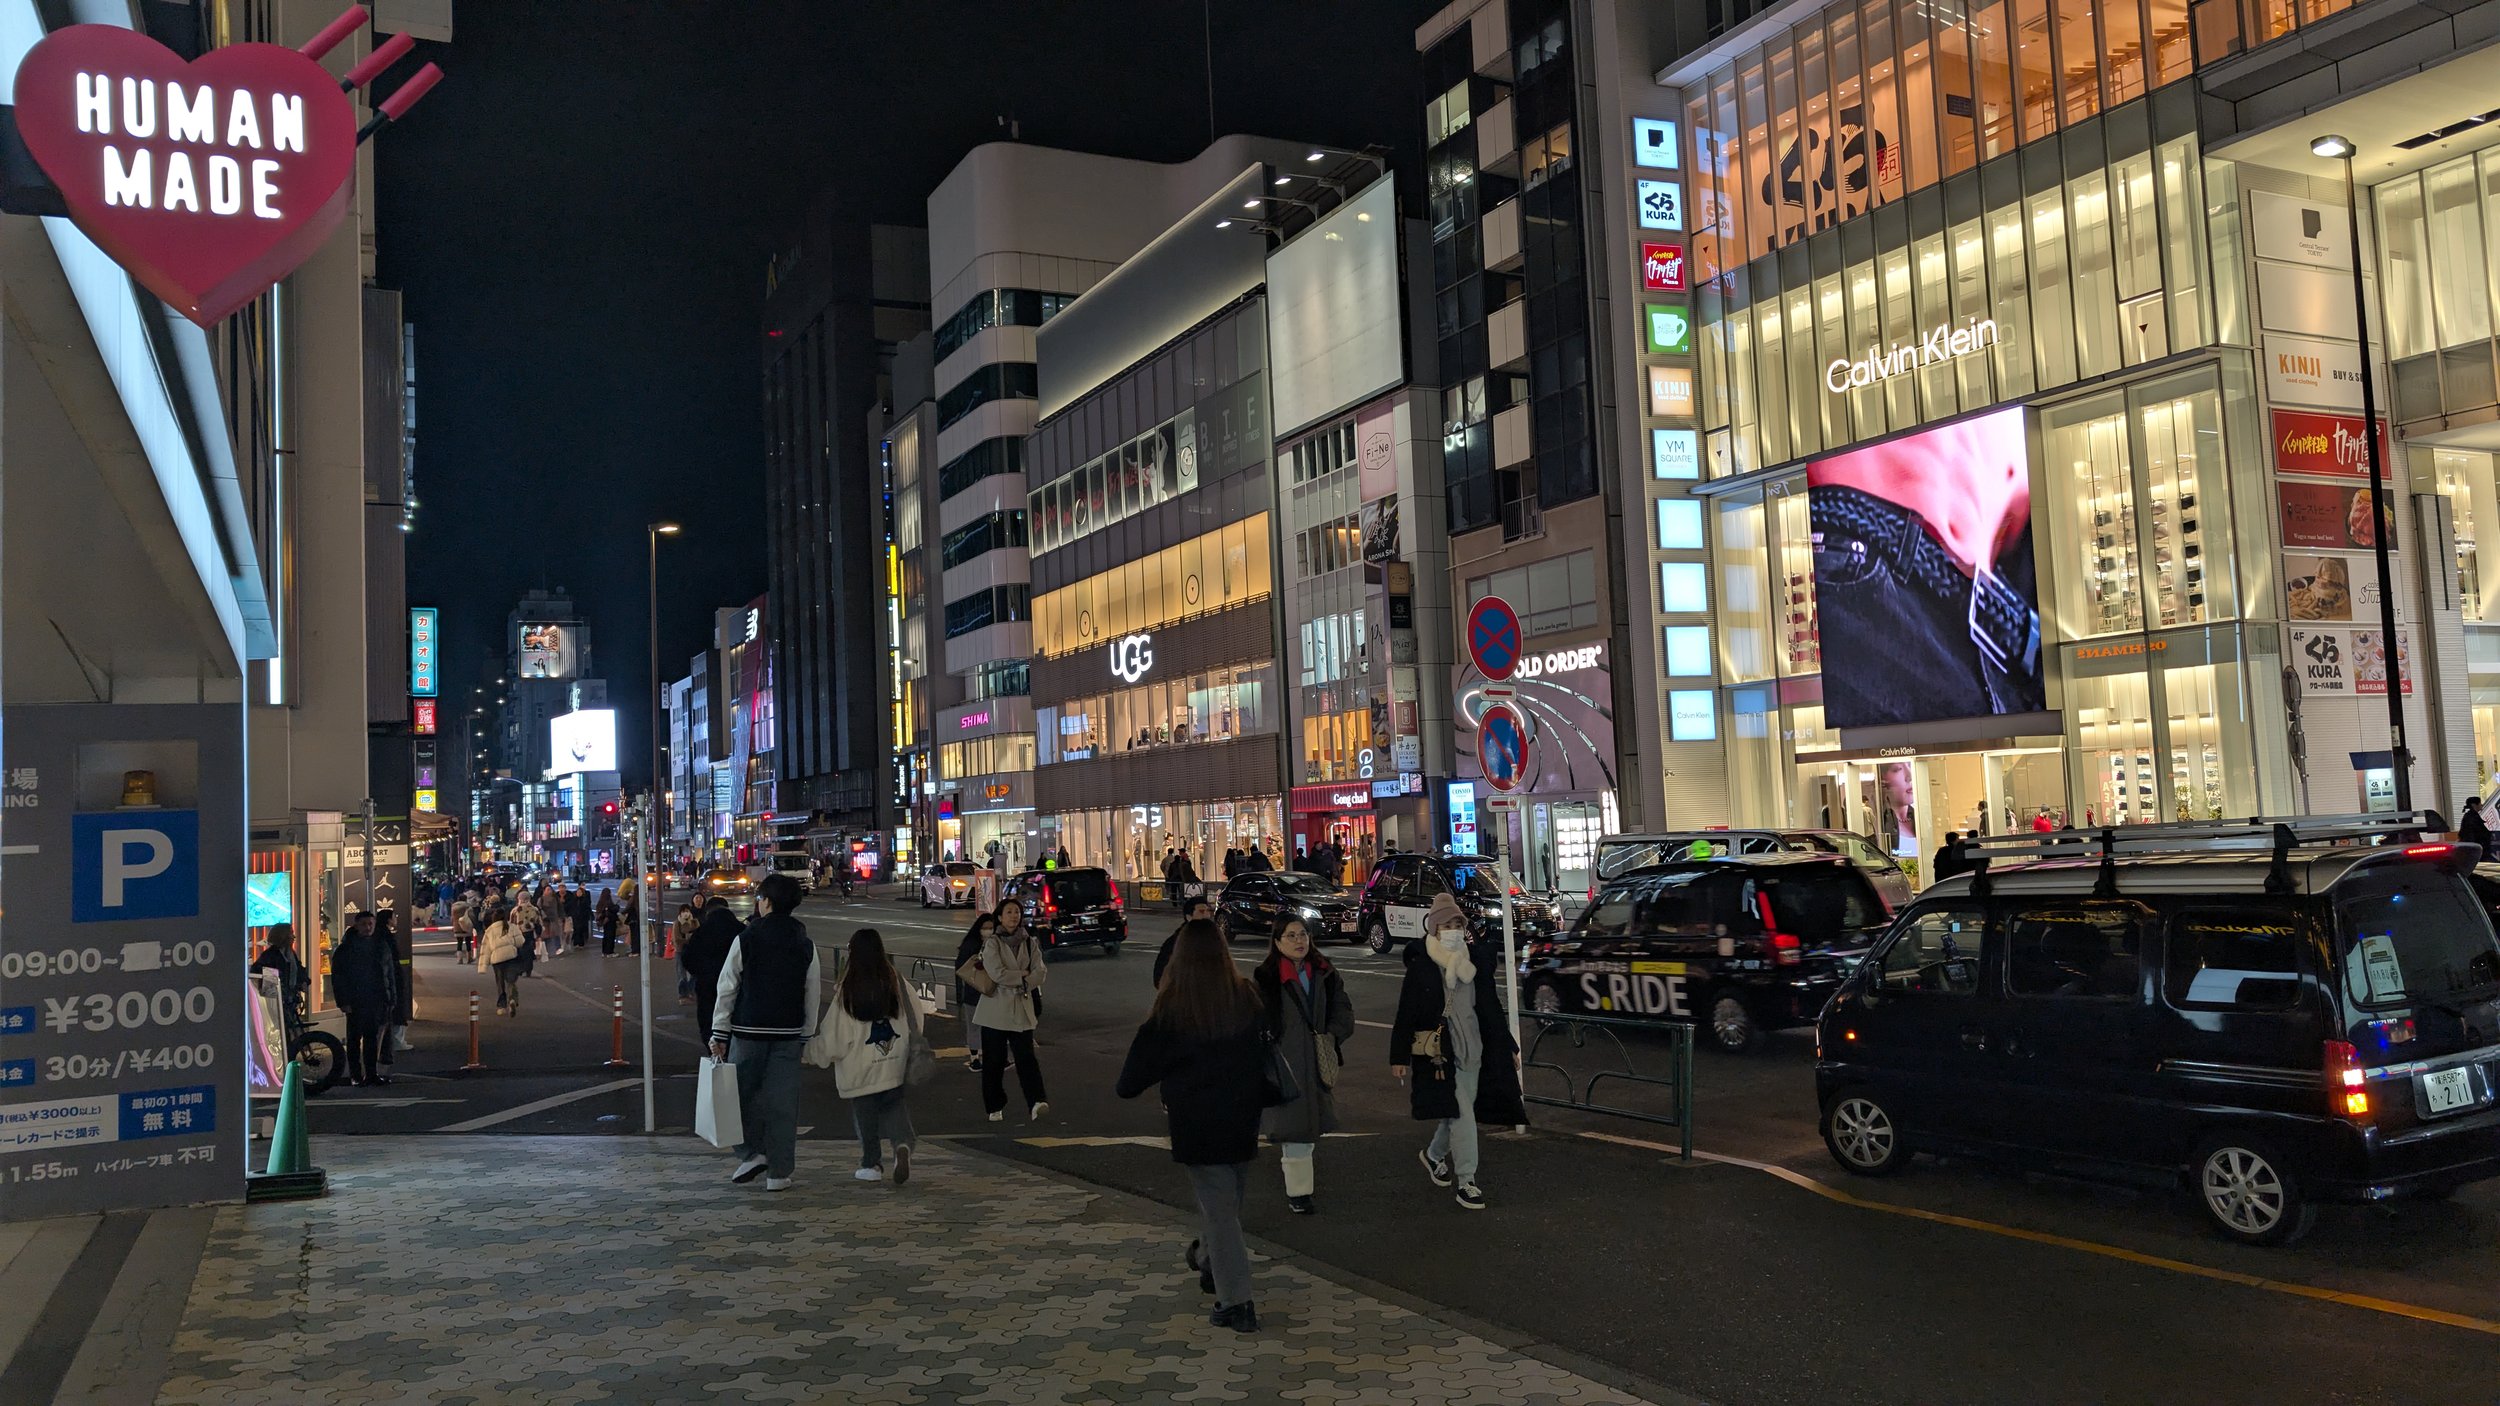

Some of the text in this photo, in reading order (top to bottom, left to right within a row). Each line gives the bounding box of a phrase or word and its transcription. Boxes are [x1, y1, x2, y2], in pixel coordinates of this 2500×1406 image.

[76, 72, 304, 153] HUMAN
[103, 145, 282, 219] MADE
[1645, 192, 1674, 211] くら
[1646, 210, 1675, 221] KURA
[1827, 317, 1998, 393] Calvin Klein
[2279, 354, 2321, 378] KINJI
[2333, 370, 2347, 380] BUY
[2349, 372, 2354, 381] &
[1655, 381, 1690, 396] KINJI
[1366, 444, 1389, 459] Fi-Ne
[1666, 440, 1685, 453] YM
[1660, 454, 1693, 463] SQUARE
[1368, 548, 1396, 562] ARONA SPA
[2294, 632, 2304, 641] 4F
[418, 615, 431, 690] カラオケ館
[2305, 635, 2340, 664] くら
[1110, 634, 1153, 683] UGG
[2308, 665, 2342, 678] KURA
[961, 713, 989, 728] SHIMA
[1677, 711, 1710, 719] Calvin Klein
[1880, 747, 1916, 757] Calvin Klein
[1333, 794, 1351, 807] Gong
[102, 828, 174, 908] P
[1581, 973, 1691, 1016] S.RIDE
[44, 986, 215, 1034] ¥3000
[131, 1093, 203, 1110] 最初の1時間
[11, 1161, 78, 1184] 1.55m
[177, 1145, 216, 1165] 不可
